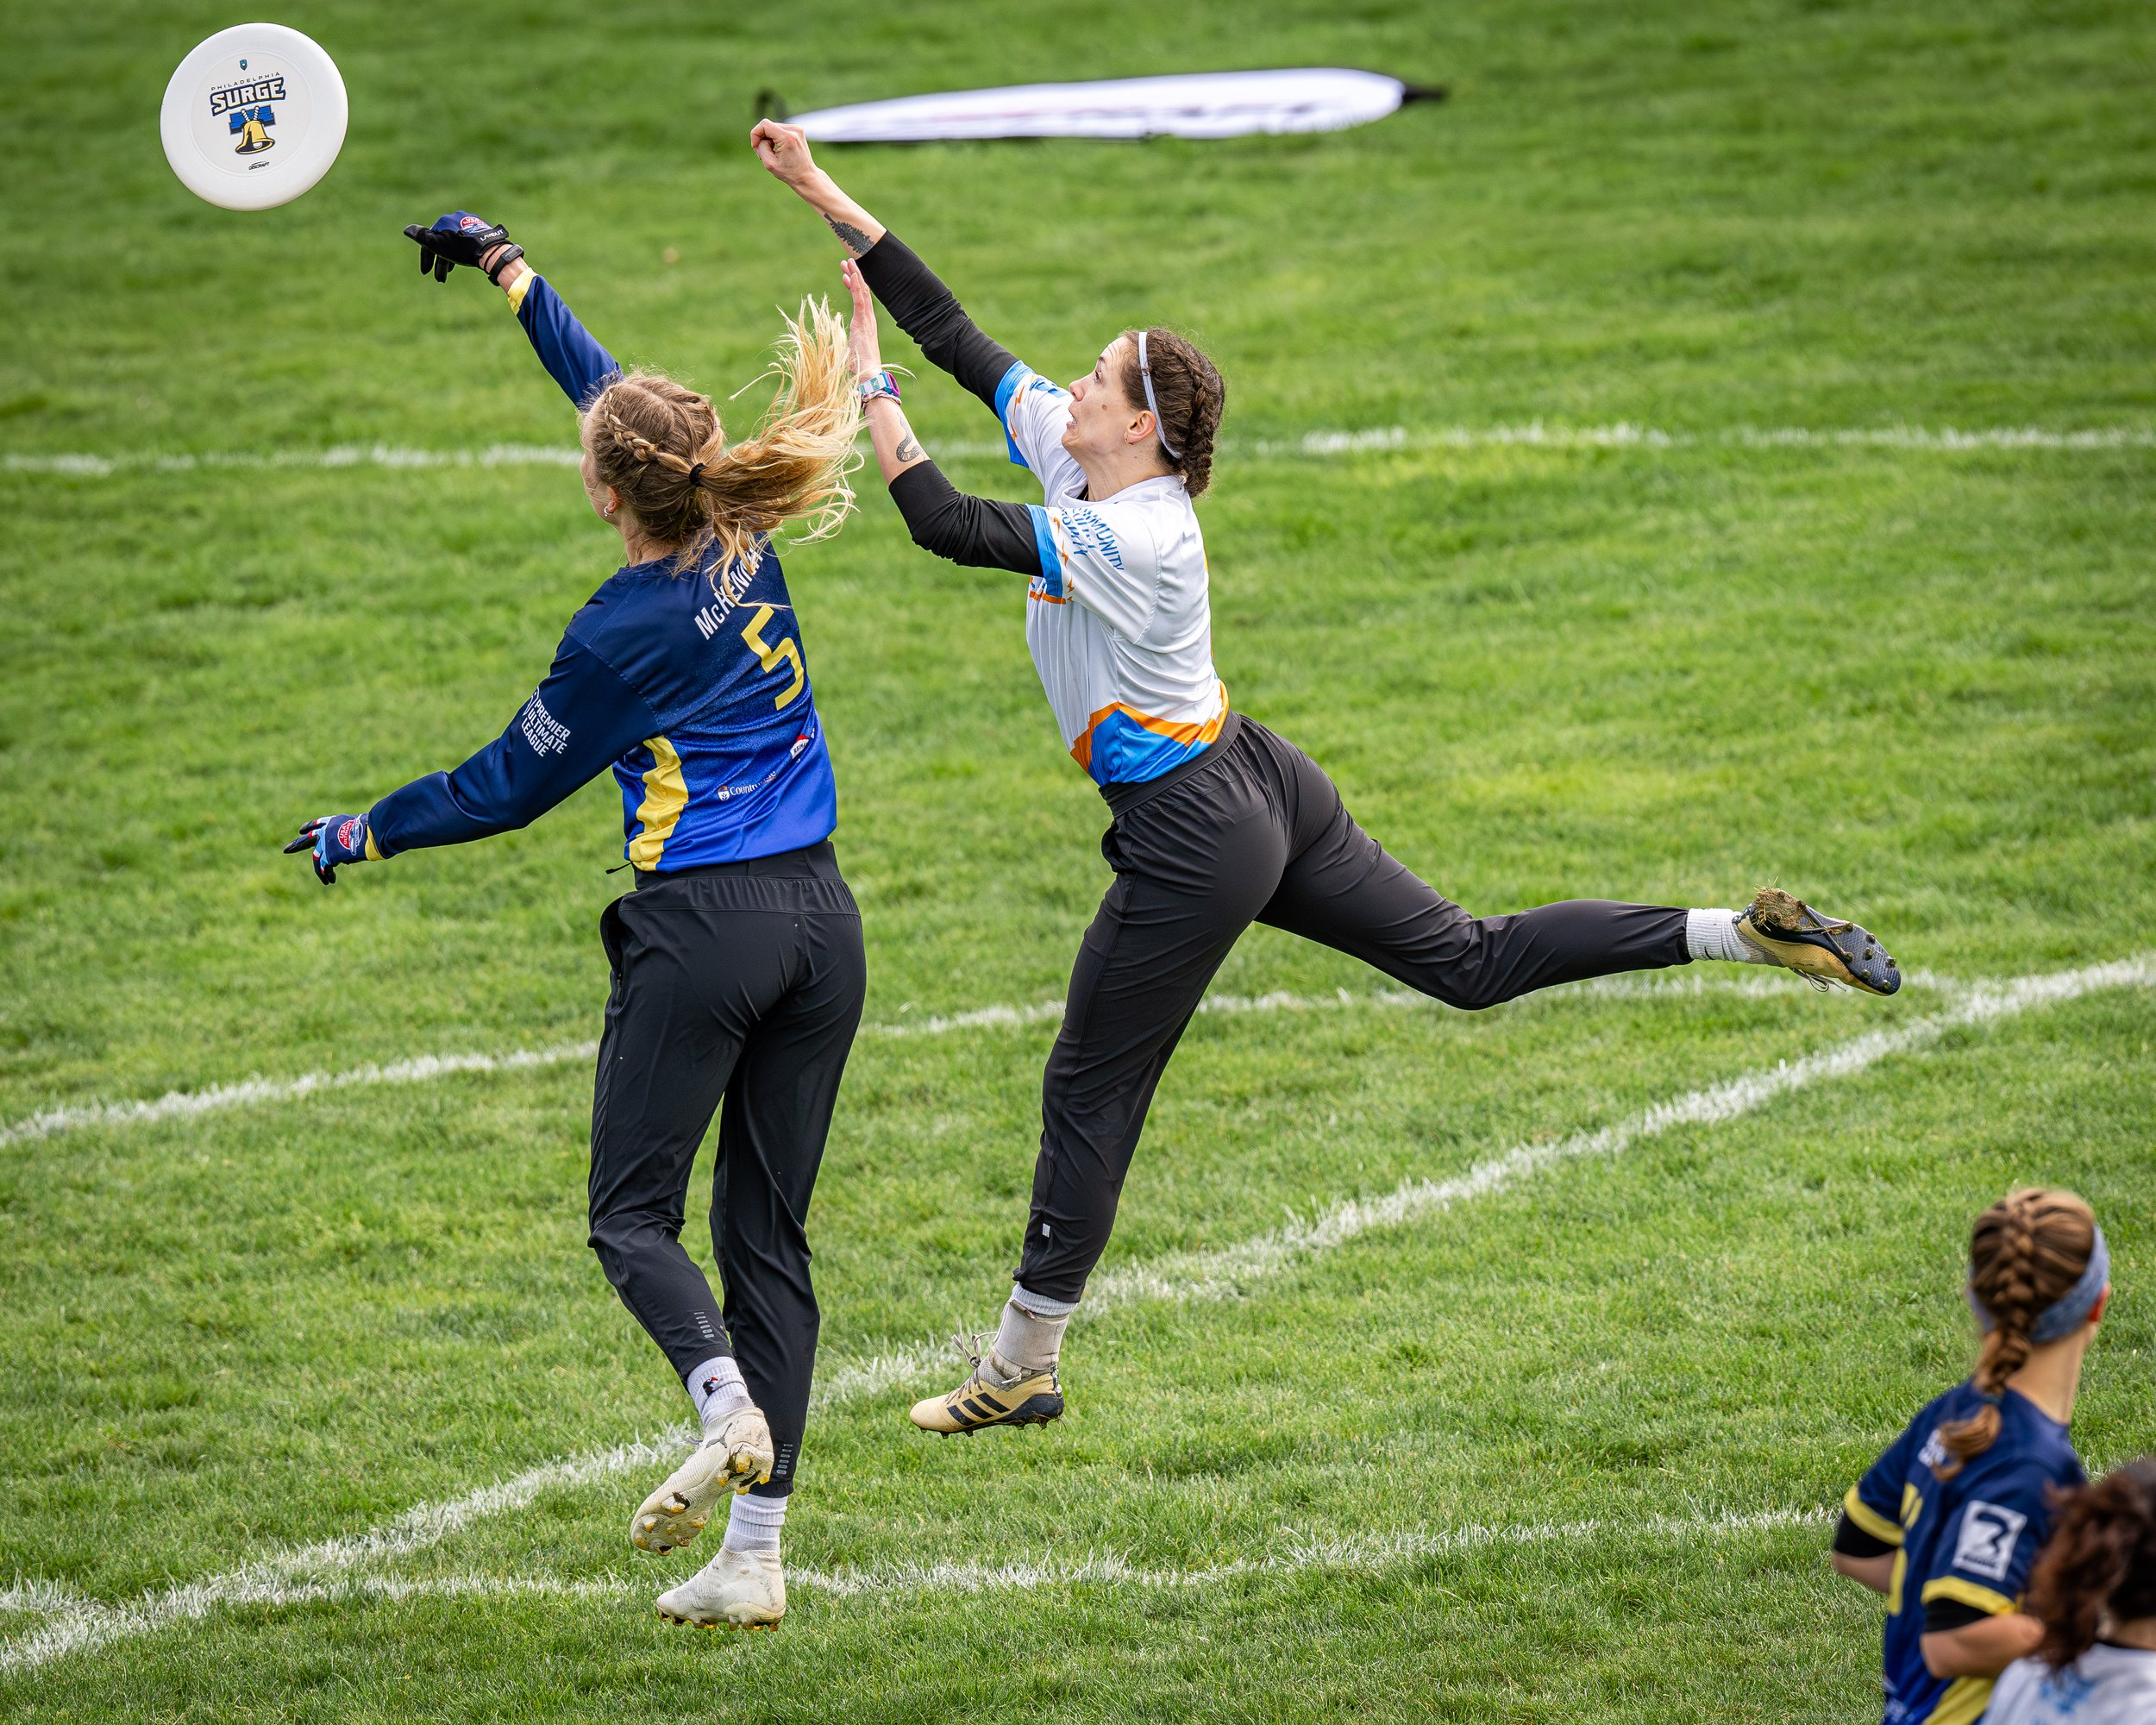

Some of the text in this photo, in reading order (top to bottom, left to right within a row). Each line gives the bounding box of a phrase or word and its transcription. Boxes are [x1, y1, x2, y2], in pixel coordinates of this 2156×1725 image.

[210, 72, 280, 91] PHILADELPHIA
[210, 77, 285, 116] SURGE
[479, 229, 504, 242] LAYOUT
[741, 605, 804, 711] 5
[521, 718, 549, 757] LEAGUE
[528, 708, 567, 754] ULTIMATE
[534, 699, 571, 741] PREMIER
